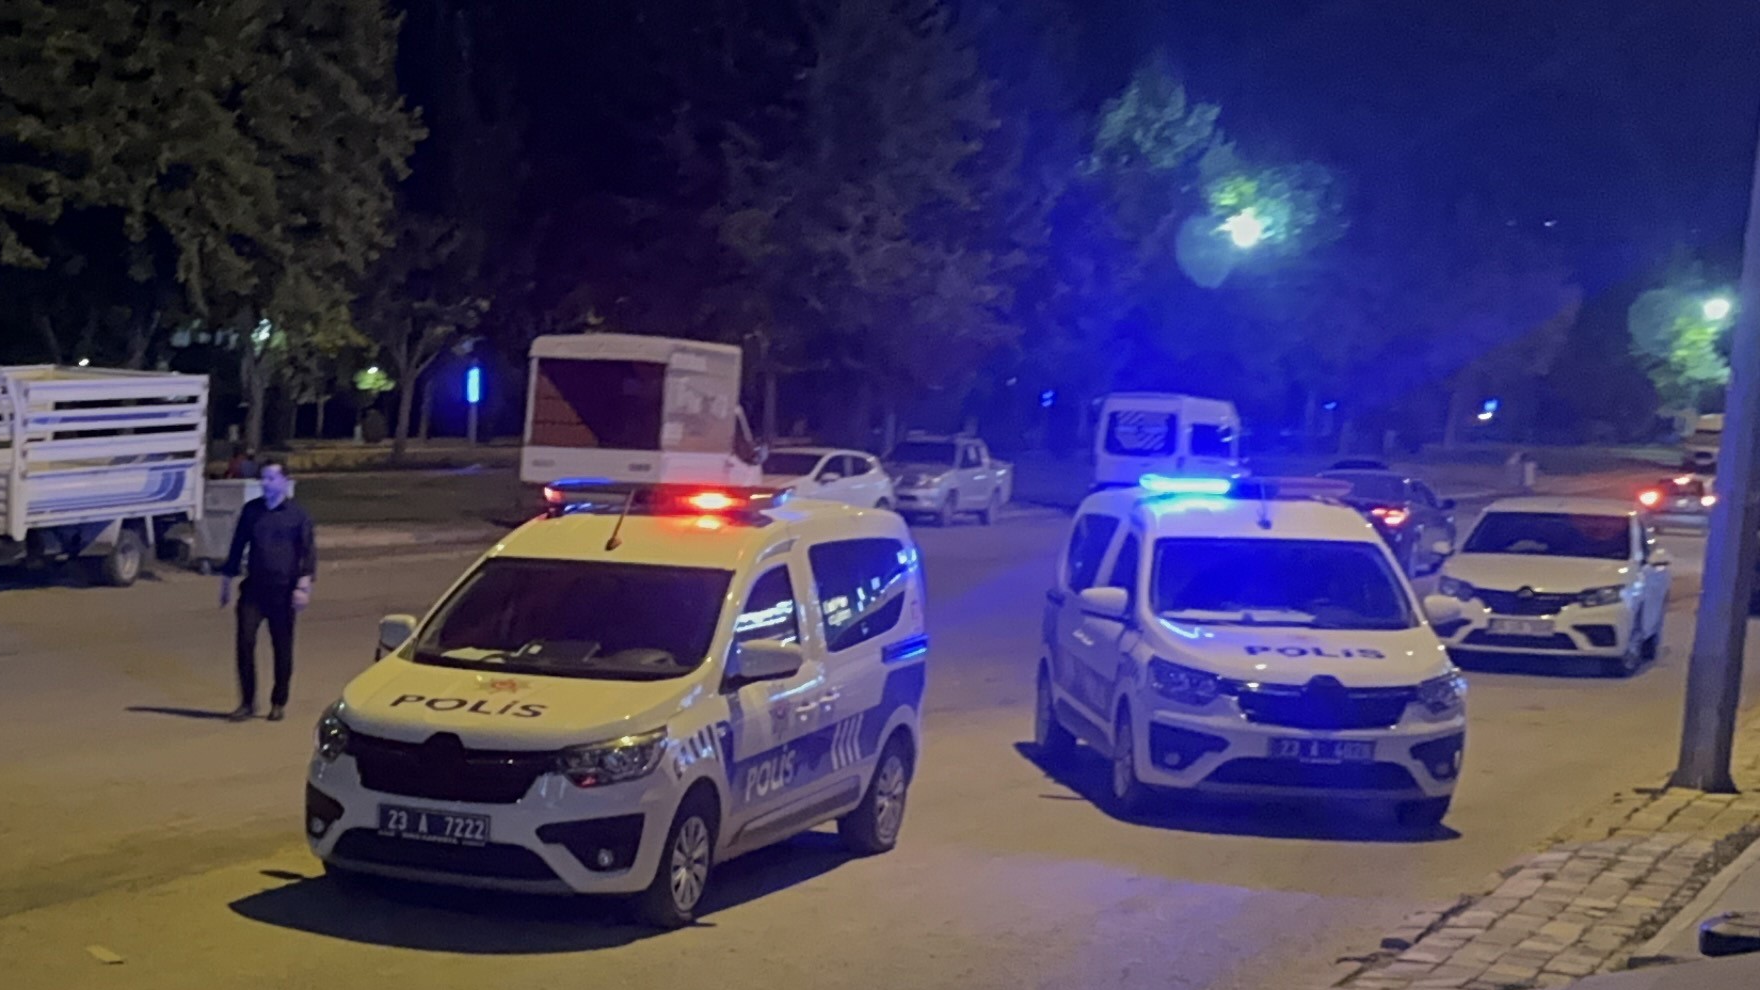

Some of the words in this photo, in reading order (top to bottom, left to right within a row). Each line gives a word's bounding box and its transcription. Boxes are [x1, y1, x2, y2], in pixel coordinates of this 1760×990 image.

[389, 693, 547, 718] POLİS
[388, 809, 408, 830] 23
[418, 813, 428, 833] A
[444, 816, 486, 840] 7222
